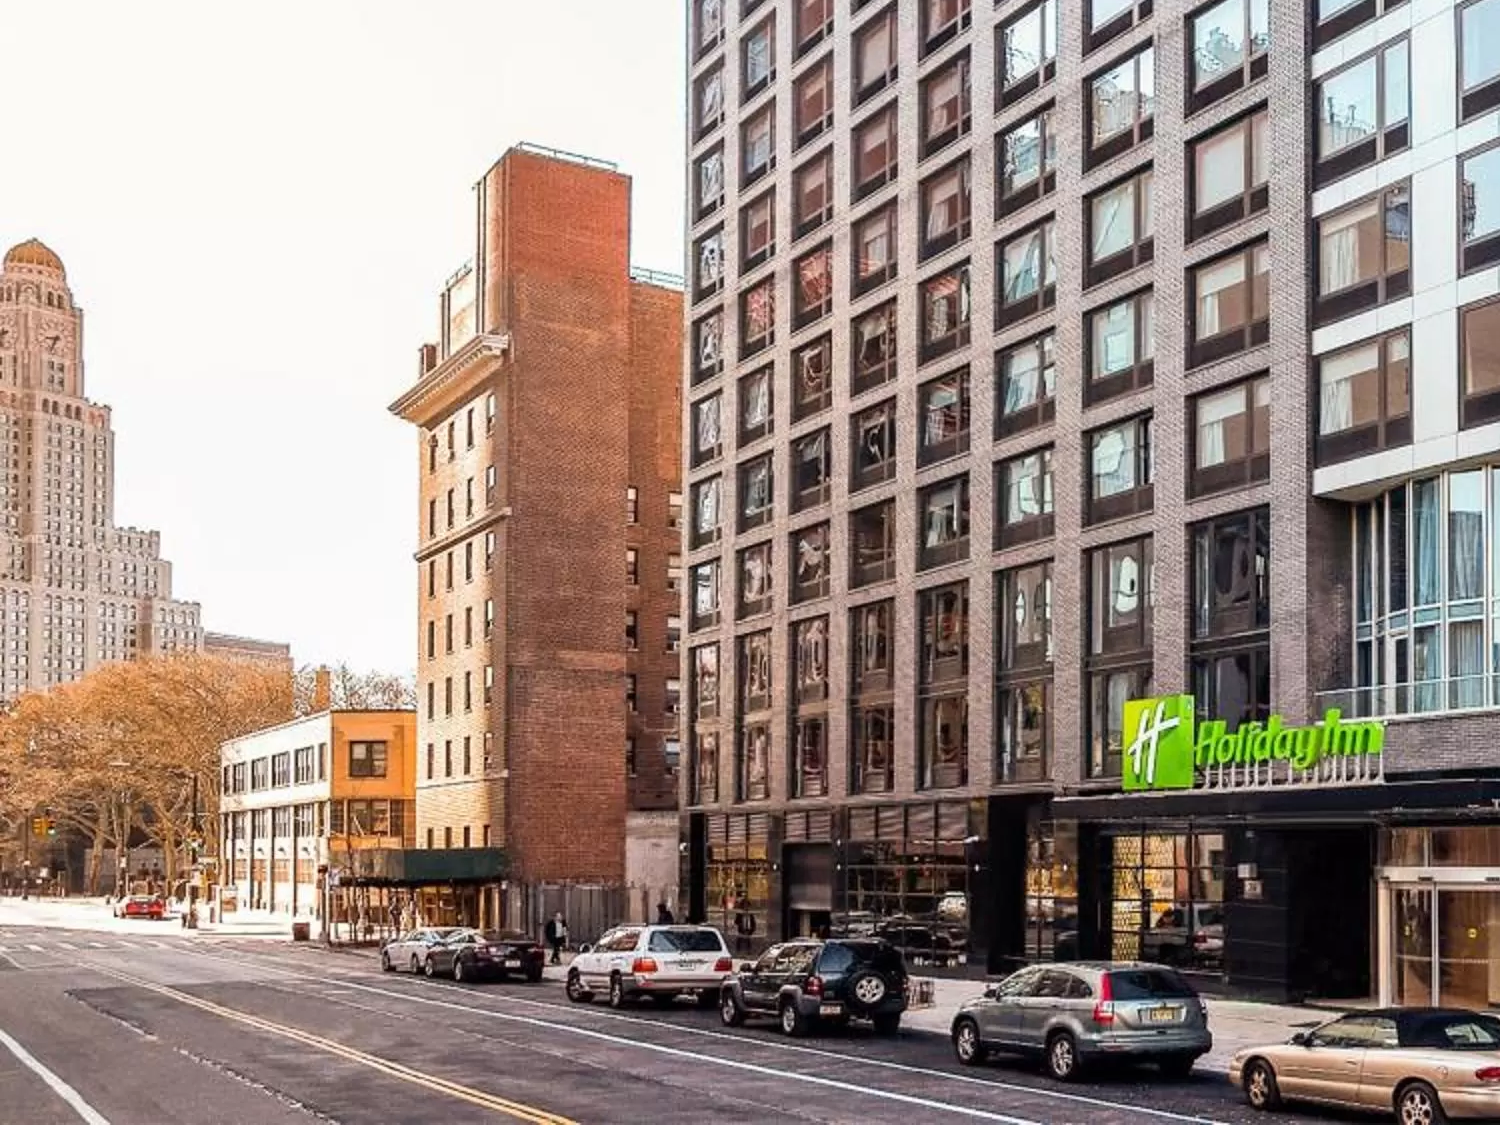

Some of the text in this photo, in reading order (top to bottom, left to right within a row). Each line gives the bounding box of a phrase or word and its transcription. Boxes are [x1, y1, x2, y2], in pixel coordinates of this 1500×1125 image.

[1127, 701, 1181, 785] H
[1195, 707, 1386, 772] Holiday Inn
